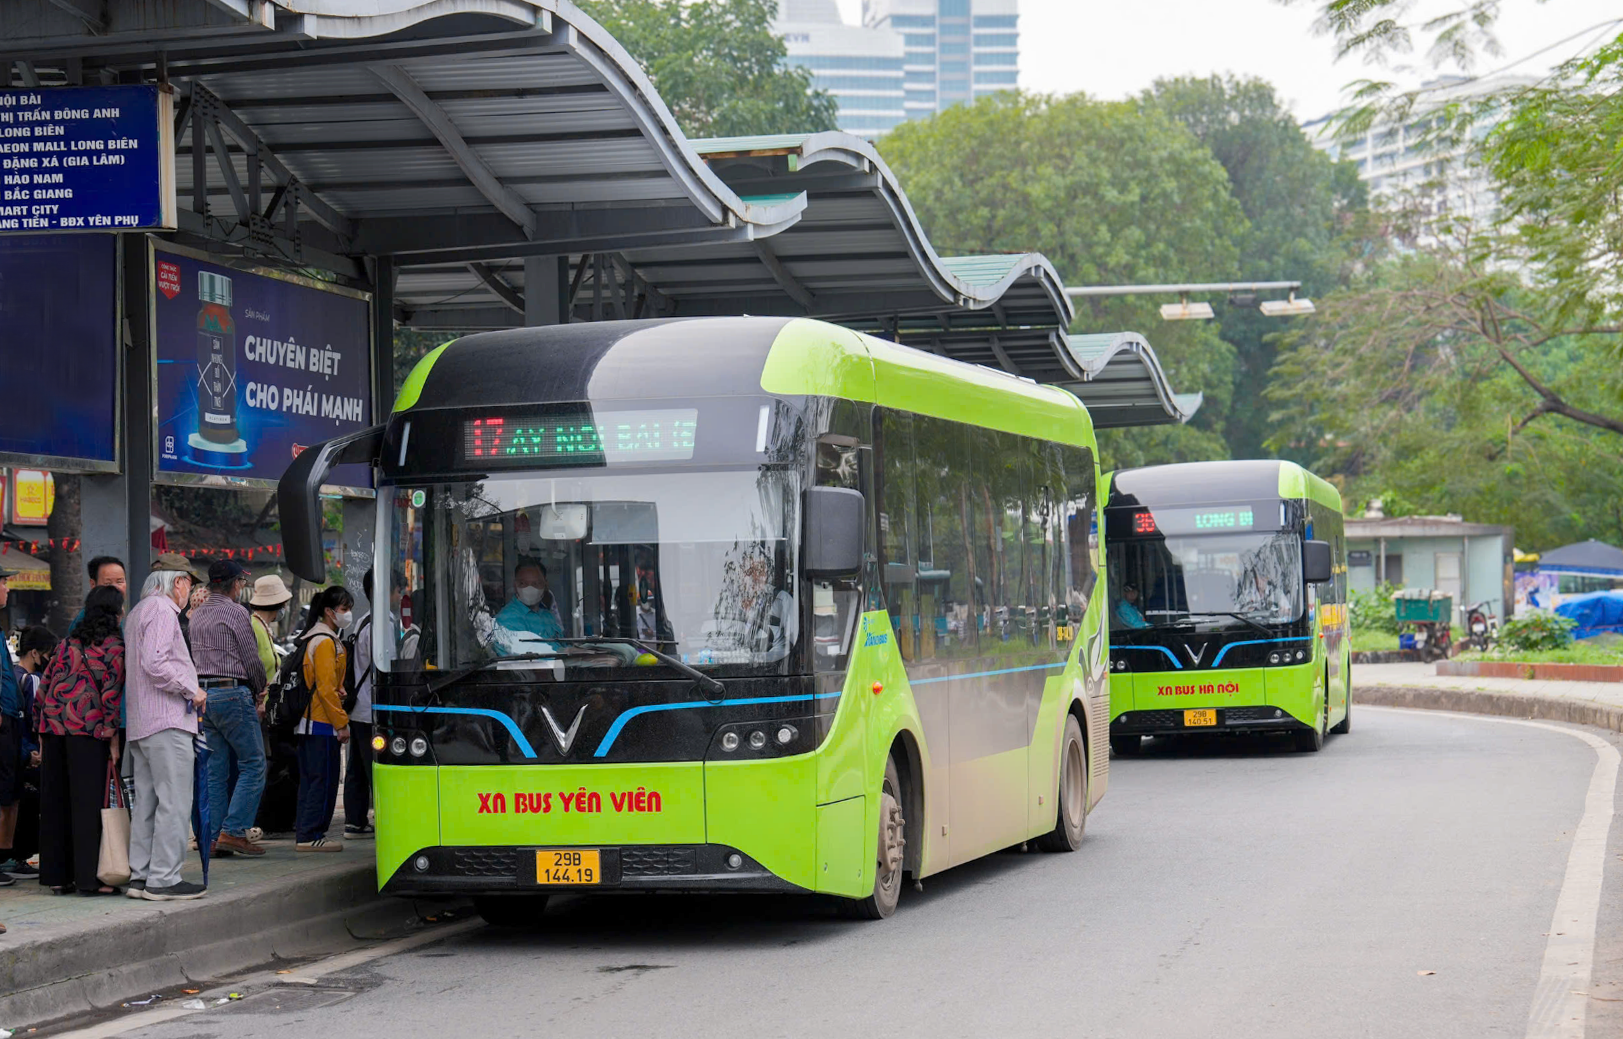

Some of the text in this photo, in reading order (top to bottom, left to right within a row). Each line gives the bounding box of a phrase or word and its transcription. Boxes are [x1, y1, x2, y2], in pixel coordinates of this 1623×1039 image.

[20, 93, 41, 105] BÀI
[17, 107, 51, 121] TRẤN
[54, 108, 89, 120] ĐÔNG
[93, 108, 120, 118] ANH
[34, 124, 65, 136] BIÊN
[33, 141, 67, 152] MALL
[71, 139, 104, 151] LONG
[108, 137, 138, 150] BIÊN
[3, 153, 125, 170] ĐẶNG XÁ (GIA LÂM)
[4, 171, 63, 185] HÀO NAM
[4, 186, 73, 200] BẮC GIANG
[32, 204, 59, 215] CITY
[60, 216, 85, 227] BĐX
[88, 214, 112, 226] YÊN
[115, 215, 139, 228] PHỤ
[245, 335, 341, 381] CHUYÊN BIỆT
[245, 381, 363, 426] CHO PHÁI MẠNH
[1195, 512, 1235, 529] LONG
[1175, 684, 1195, 695] BUS
[1199, 681, 1214, 695] HÀ
[1217, 681, 1239, 697] NỘI
[477, 786, 662, 814] XN BUS YÊN VIÊN
[554, 852, 581, 866] 29B
[545, 868, 593, 882] 144.19
